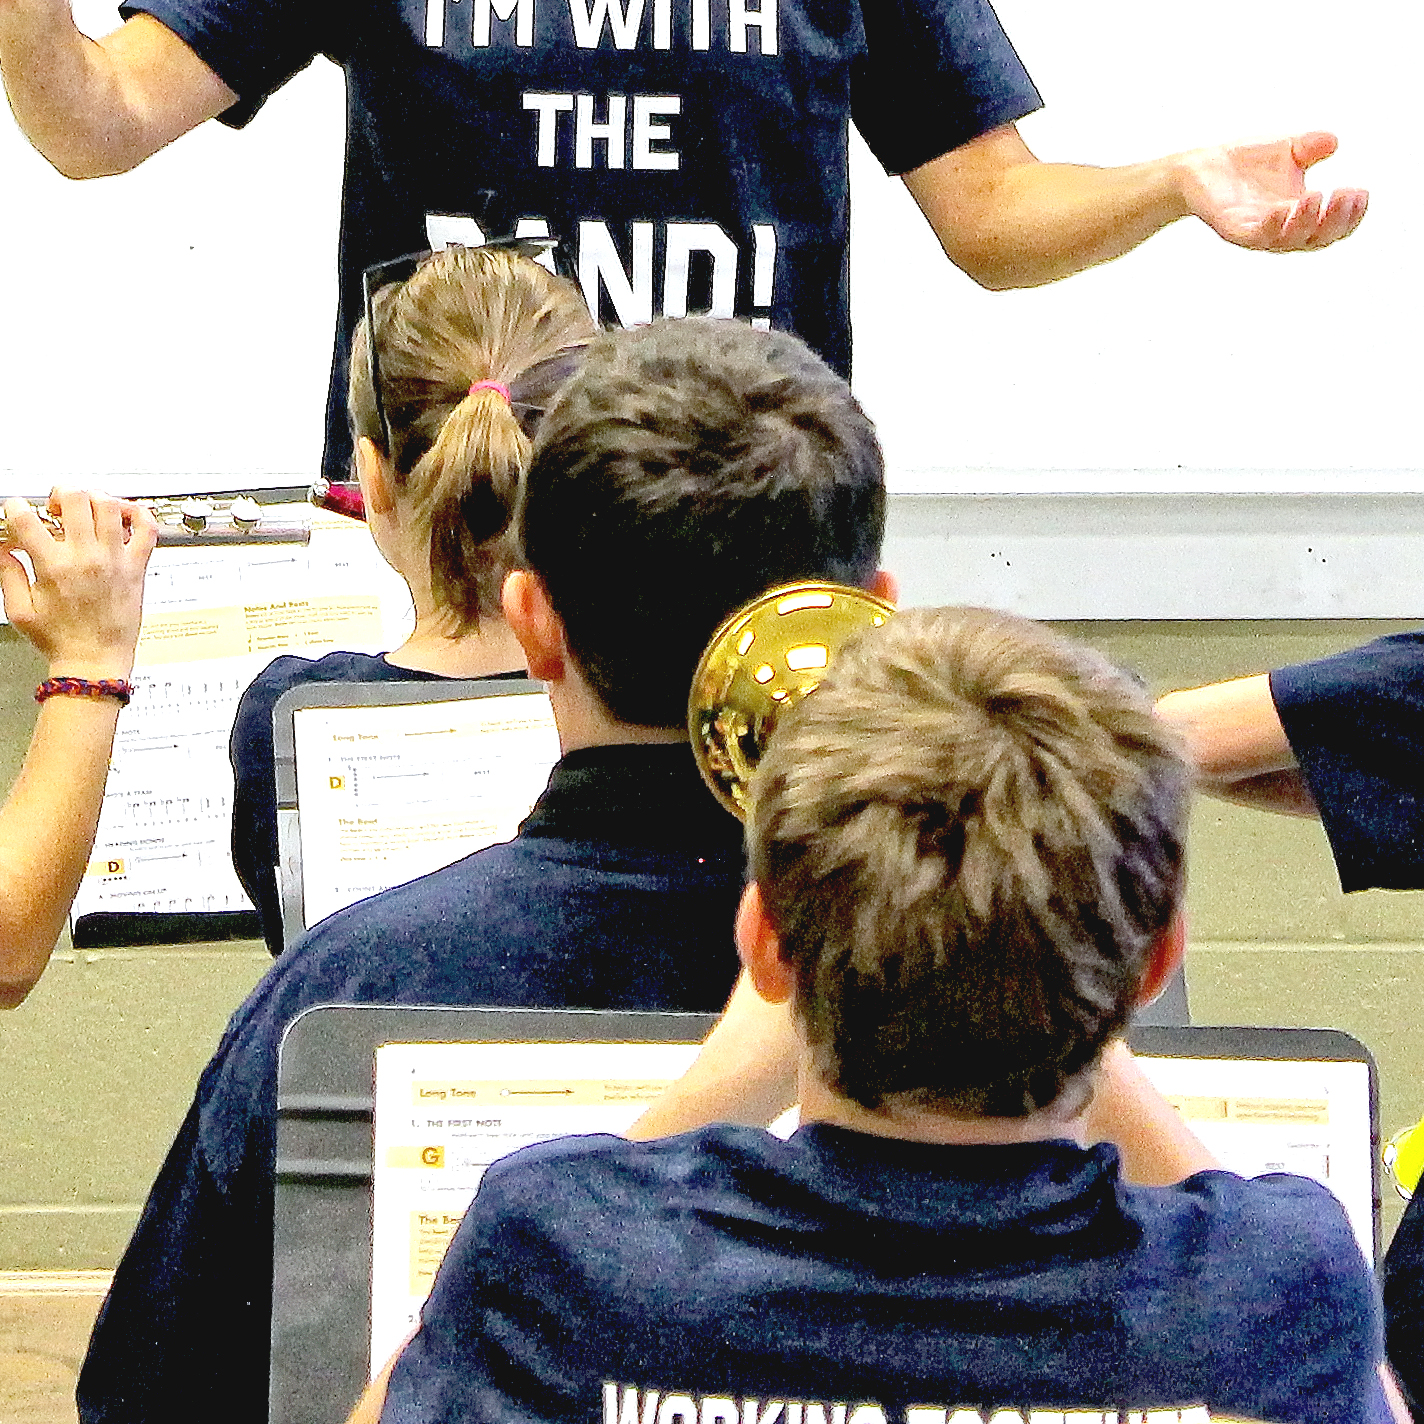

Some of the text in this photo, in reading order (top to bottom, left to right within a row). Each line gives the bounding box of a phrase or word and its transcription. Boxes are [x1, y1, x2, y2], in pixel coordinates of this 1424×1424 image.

[522, 93, 682, 171] THE
[329, 776, 342, 789] D
[419, 1088, 447, 1101] Long
[421, 1146, 440, 1164] G
